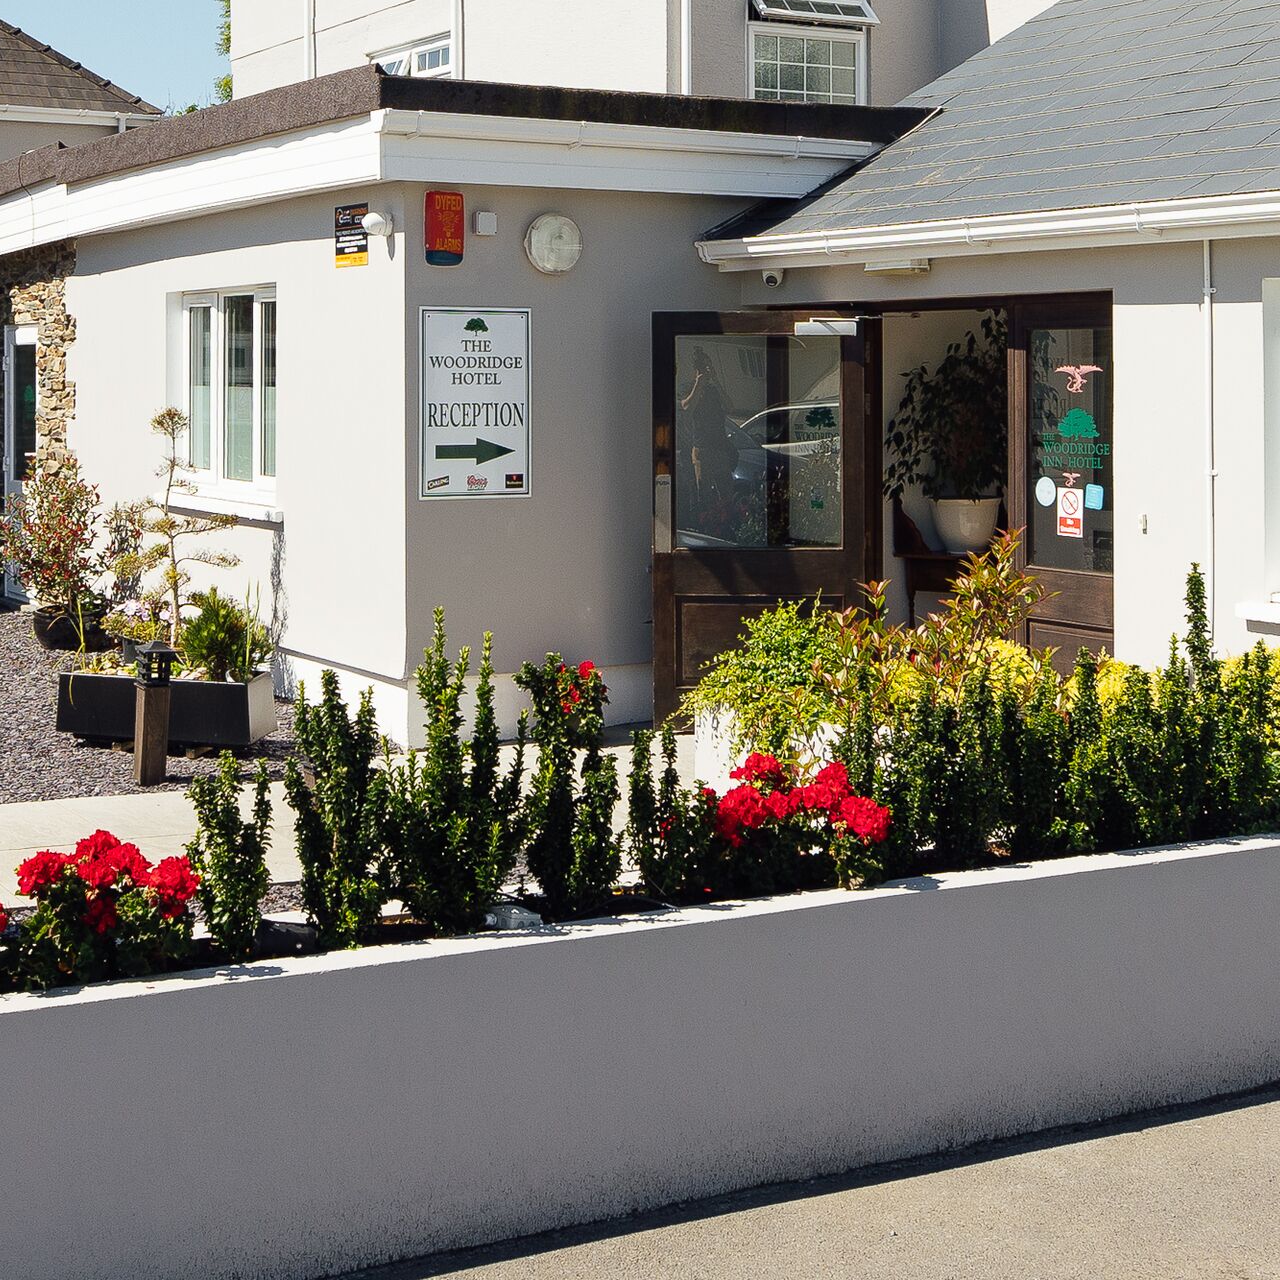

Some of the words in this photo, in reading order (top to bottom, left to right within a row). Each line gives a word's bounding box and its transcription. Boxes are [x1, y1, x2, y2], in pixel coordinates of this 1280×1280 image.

[435, 195, 462, 210] DYFED
[435, 238, 462, 251] ALARMS
[461, 340, 492, 352] THE
[429, 356, 523, 369] WOODRIDGE
[451, 373, 502, 385] HOTEL
[428, 402, 525, 428] RECEPTION
[1042, 432, 1055, 440] THE
[1043, 441, 1111, 455] WOODRIDGE
[1042, 455, 1063, 467] INN
[1068, 457, 1104, 469] HOTEL
